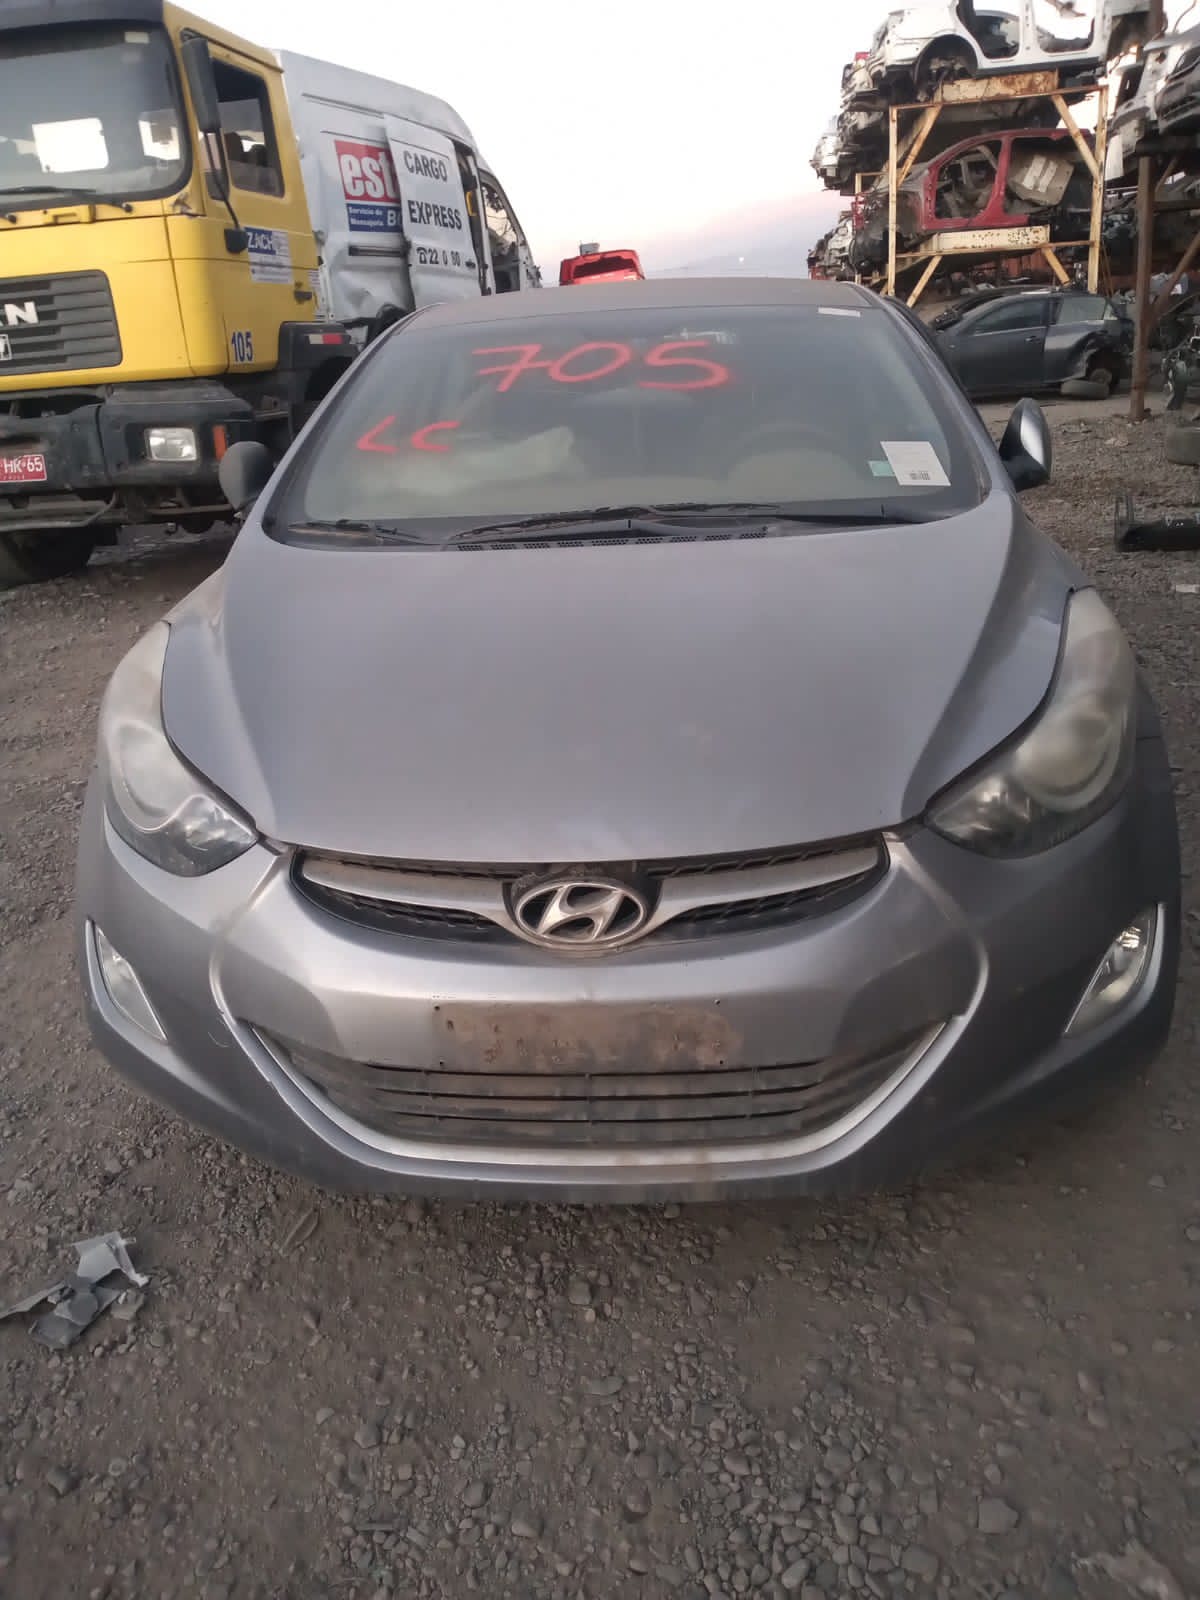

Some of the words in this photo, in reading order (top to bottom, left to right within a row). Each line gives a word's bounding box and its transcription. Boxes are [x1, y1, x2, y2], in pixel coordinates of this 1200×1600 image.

[403, 150, 448, 182] CARGO
[408, 199, 463, 231] EXPRESS
[231, 331, 253, 362] 105
